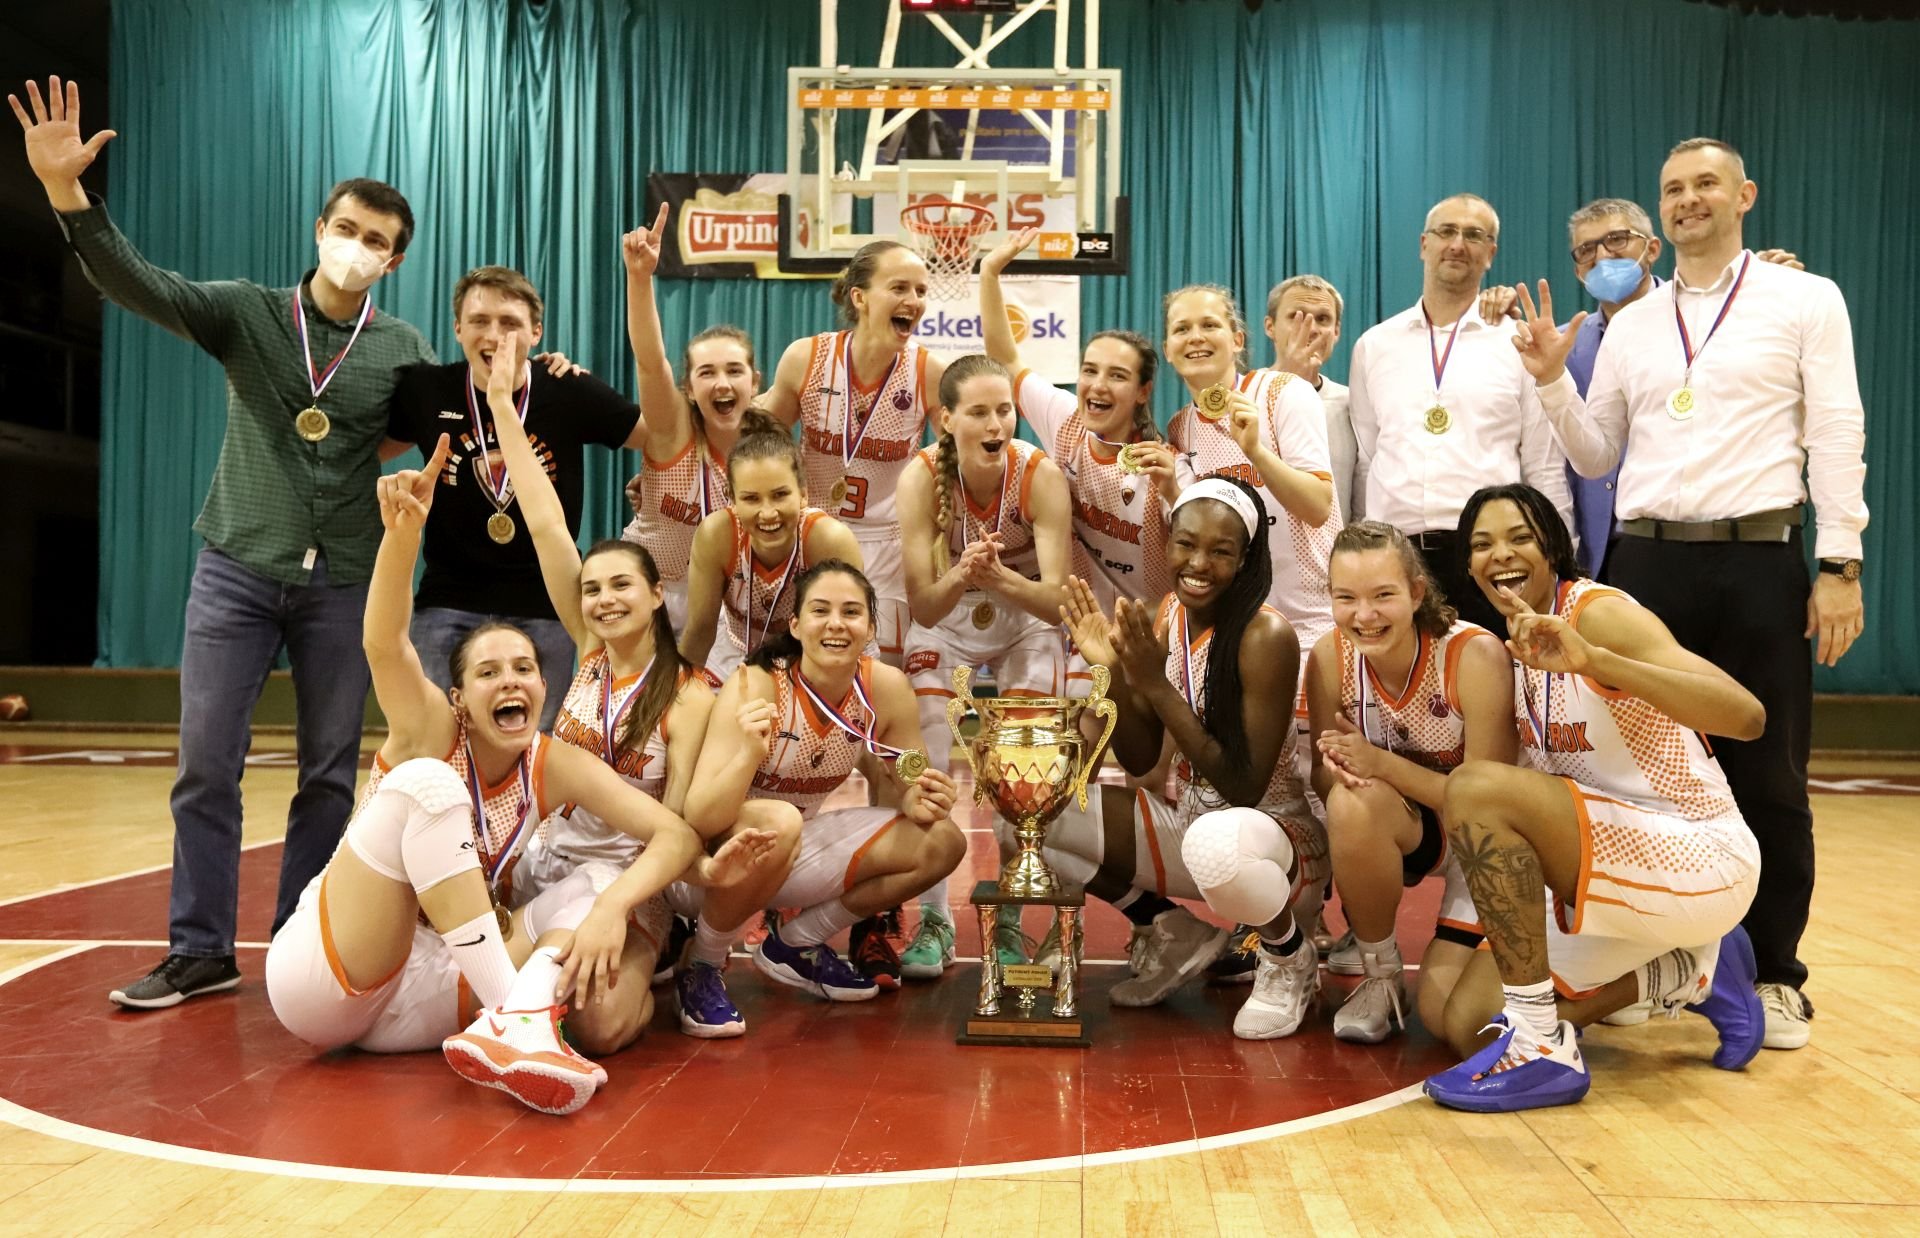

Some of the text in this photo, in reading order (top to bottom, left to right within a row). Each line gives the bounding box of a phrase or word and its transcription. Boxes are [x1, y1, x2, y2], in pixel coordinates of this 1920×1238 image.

[1032, 312, 1066, 338] sk
[839, 475, 869, 519] 3
[1104, 558, 1134, 575] scp
